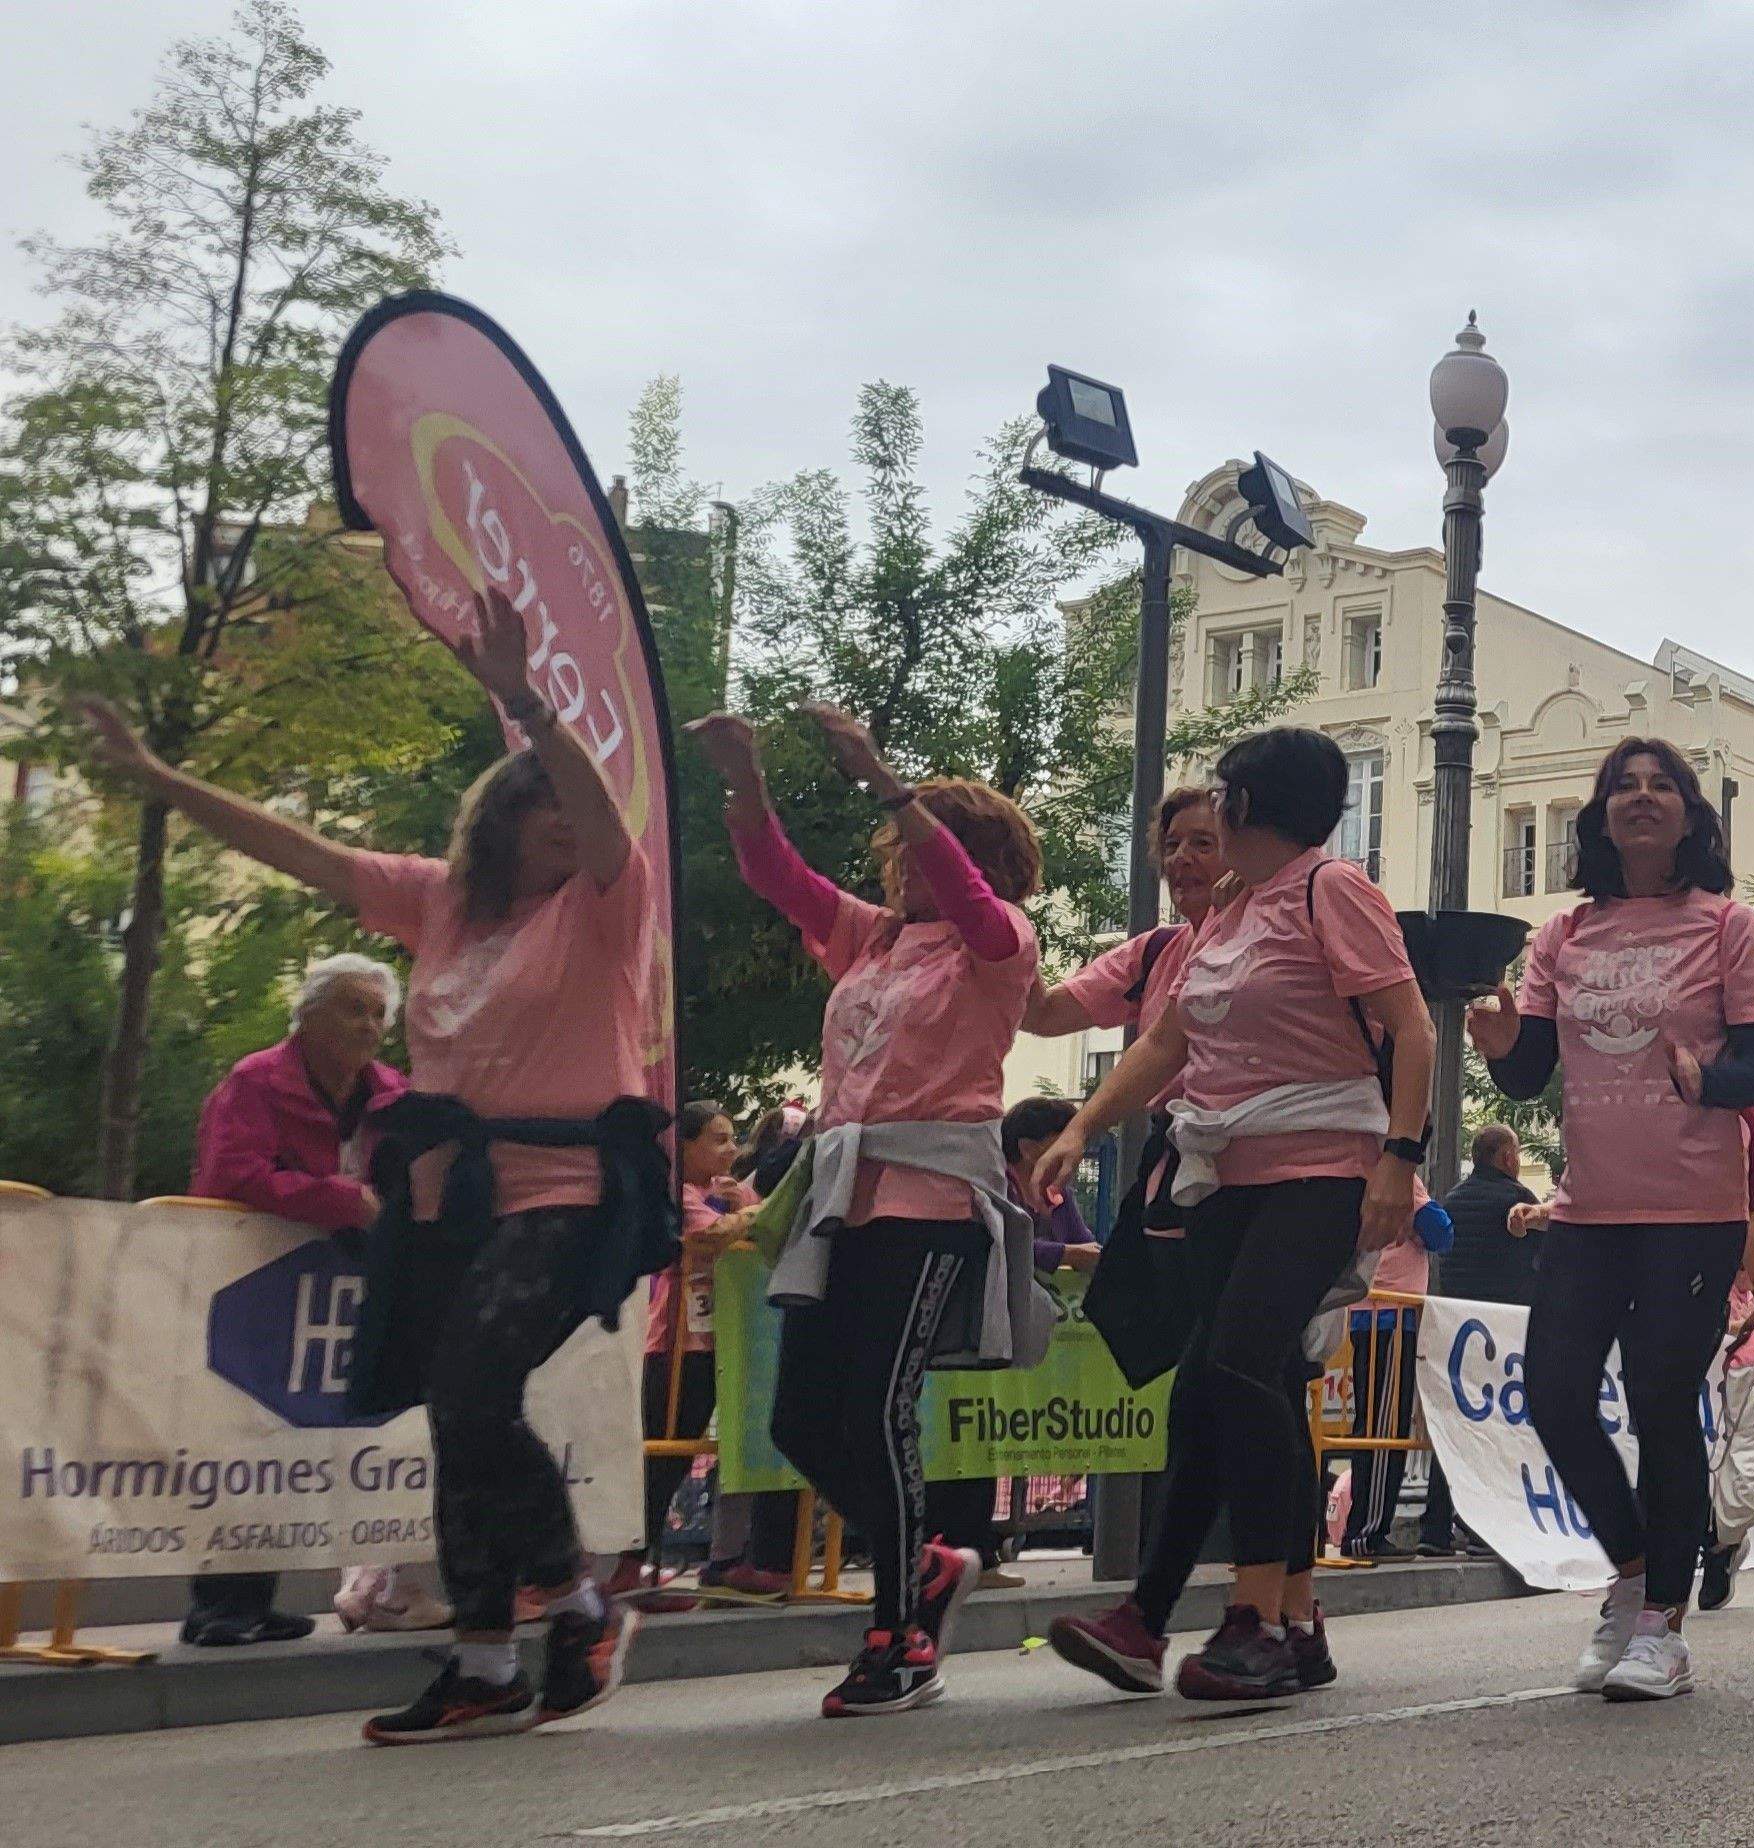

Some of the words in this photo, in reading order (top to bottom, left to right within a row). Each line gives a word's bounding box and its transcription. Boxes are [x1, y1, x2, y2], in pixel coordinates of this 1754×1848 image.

[917, 1253, 955, 1339] adidas
[949, 1396, 1156, 1443] FiberStudio
[22, 1446, 335, 1510] Hormigones
[350, 1444, 428, 1493] Gra
[205, 1520, 332, 1553] ASFALTOS
[350, 1516, 433, 1546] OBRAS
